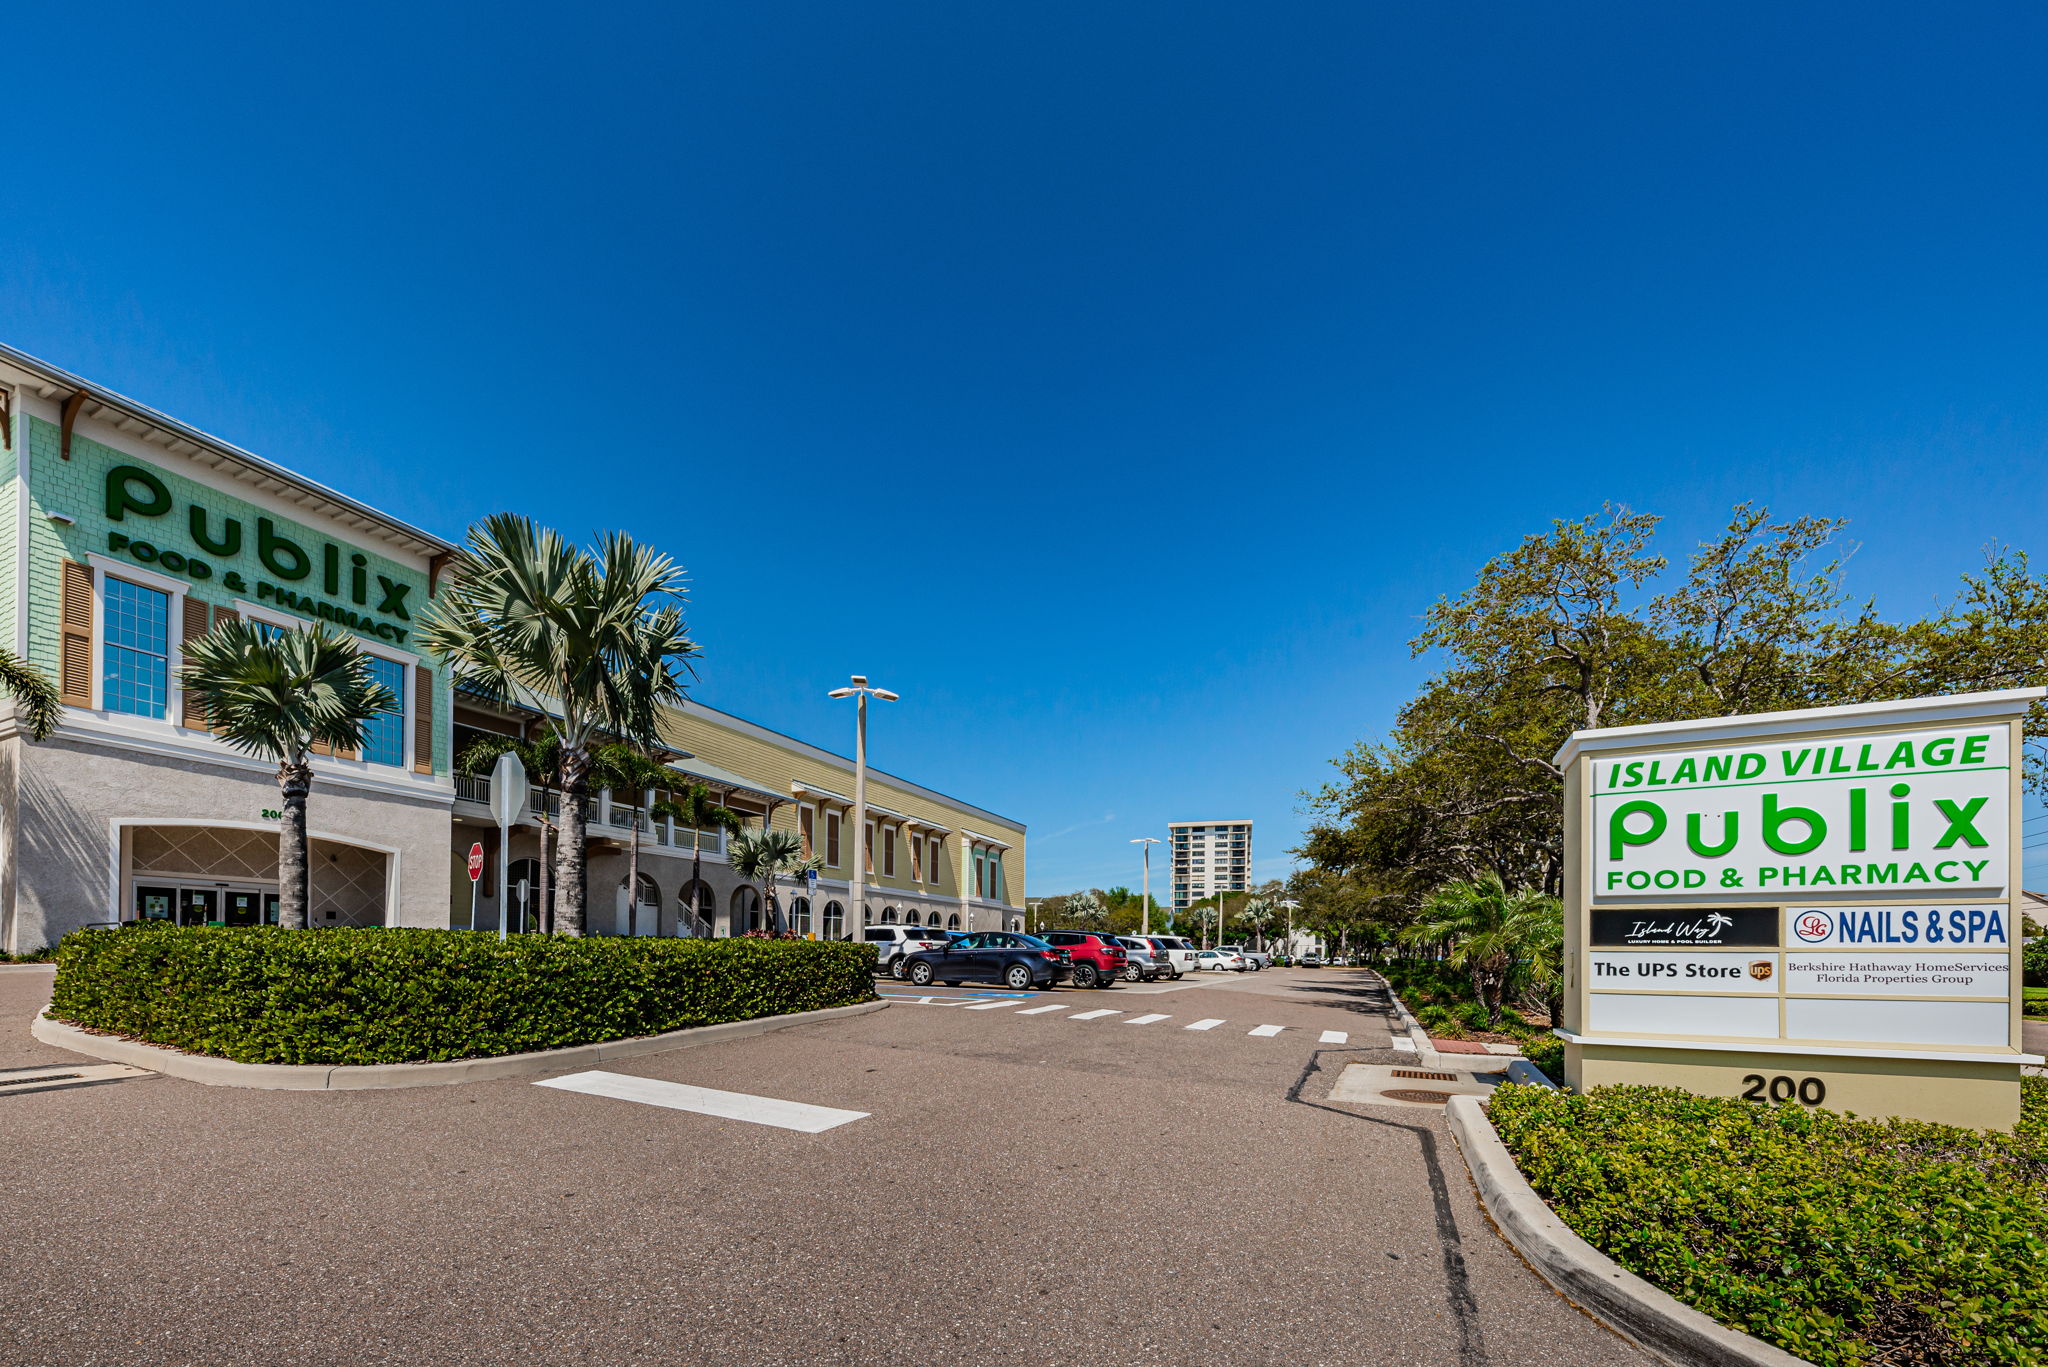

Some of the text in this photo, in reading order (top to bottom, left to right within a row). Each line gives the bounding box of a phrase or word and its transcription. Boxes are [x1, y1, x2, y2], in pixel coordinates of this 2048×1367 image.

[106, 465, 412, 621] Publix
[108, 531, 409, 644] FOOD & PHARMACY
[1608, 735, 1990, 788] ISLAND VILLAGE
[1609, 783, 1989, 861] Publix
[469, 854, 483, 870] STOP
[1607, 860, 1989, 890] FOOD & PHARMACY
[1625, 919, 1710, 938] Island Way
[1839, 911, 1919, 943] NAILS
[1926, 910, 1944, 943] &
[1948, 910, 2006, 943] SPA
[1594, 962, 1741, 978] The UPS Store
[1750, 965, 1771, 978] ups
[1788, 962, 2009, 973] Berkshire Hathaway HomeServices
[1816, 974, 1974, 985] Florida Properties Group
[1741, 1074, 1826, 1107] 200
